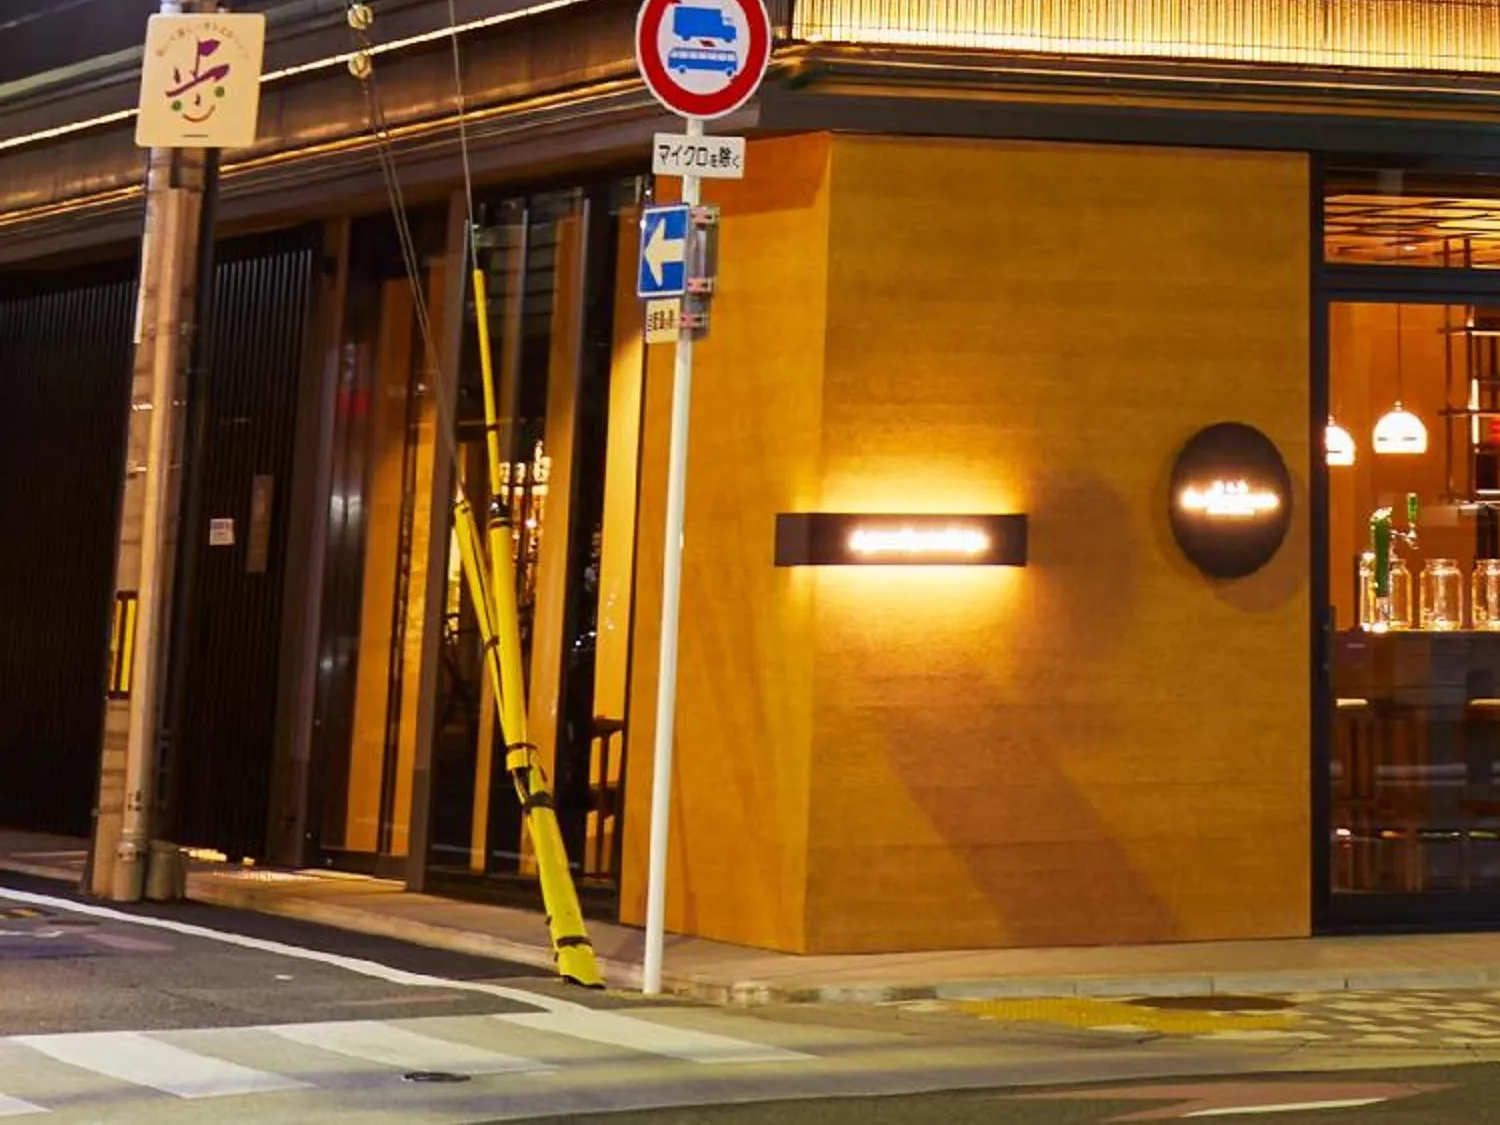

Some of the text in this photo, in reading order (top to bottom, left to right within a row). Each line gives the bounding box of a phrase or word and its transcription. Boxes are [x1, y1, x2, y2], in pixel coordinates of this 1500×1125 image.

[658, 143, 741, 169] マイクロを除く
